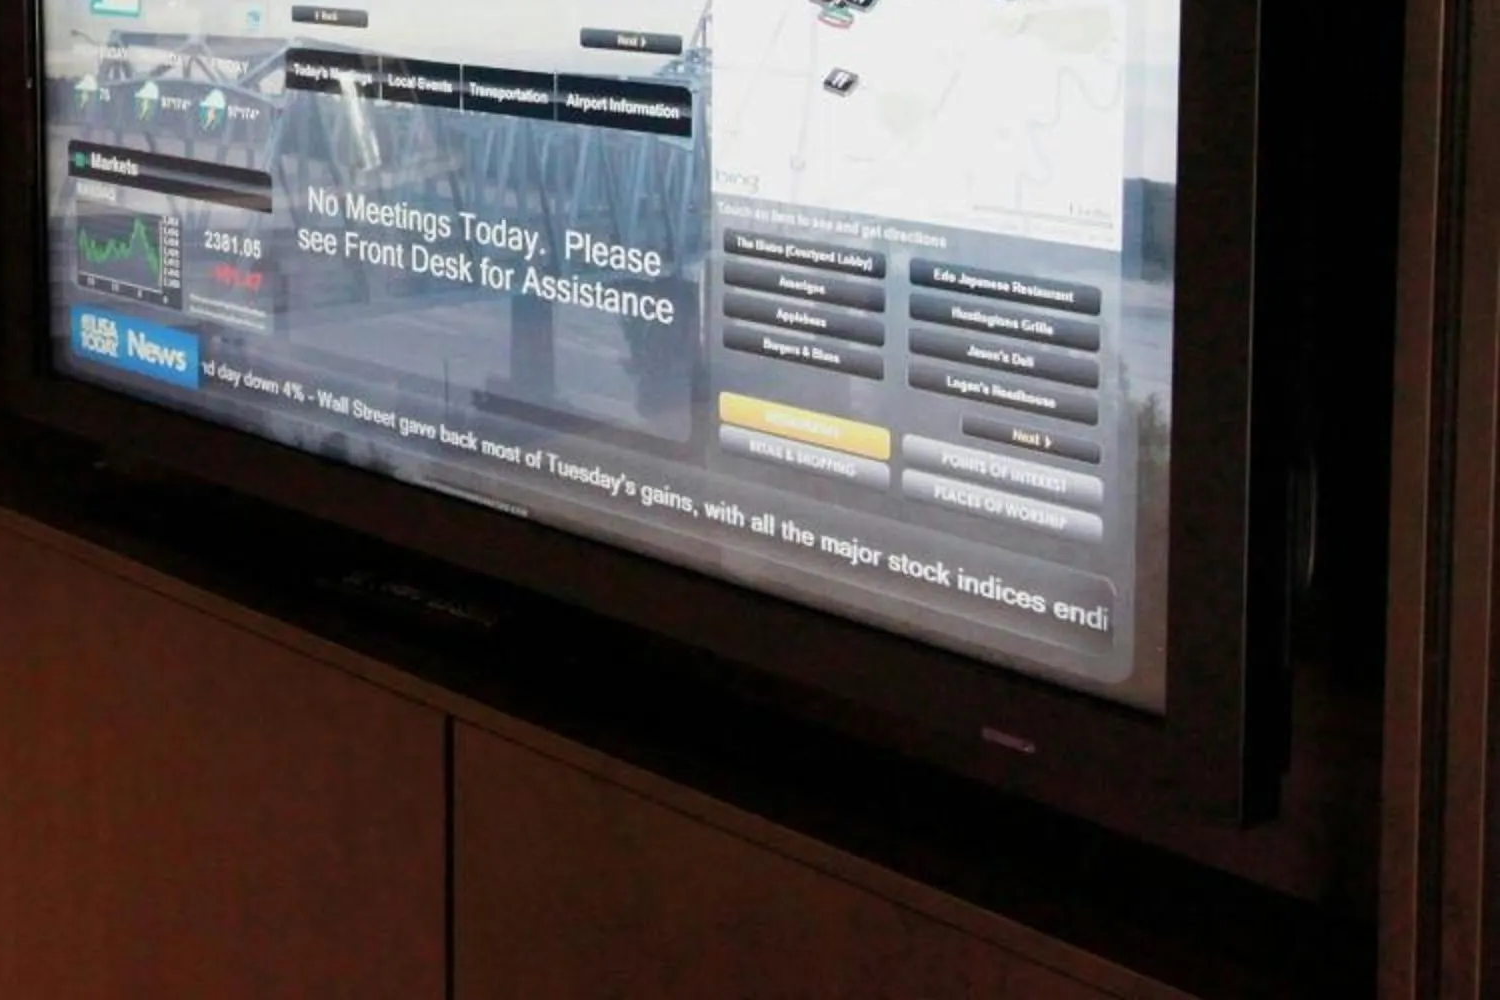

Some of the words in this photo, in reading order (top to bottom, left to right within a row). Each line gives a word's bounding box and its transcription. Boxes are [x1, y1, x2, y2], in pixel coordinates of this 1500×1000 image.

[387, 74, 416, 91] Local
[417, 77, 453, 95] Events
[469, 81, 550, 106] Transportation
[566, 92, 608, 112] Airport
[609, 96, 681, 121] Information
[90, 151, 139, 176] Markets
[306, 185, 340, 217] No
[345, 192, 453, 243] Meetings
[458, 211, 547, 261] Today.
[564, 230, 662, 277] Please
[835, 219, 860, 235] and
[861, 223, 883, 240] get
[203, 229, 263, 261] 2381.05
[297, 226, 338, 257] see
[344, 231, 405, 270] Front
[410, 245, 474, 284] Desk
[479, 256, 515, 292] for
[522, 268, 675, 326] Assistance
[1011, 281, 1075, 304] Restaurant
[126, 329, 188, 372] News
[1012, 427, 1041, 447] Next
[989, 460, 1010, 480] OF
[217, 363, 242, 388] day
[243, 371, 280, 397] down
[281, 381, 306, 404] 4%
[316, 388, 350, 418] Wall
[352, 400, 397, 430] Street
[399, 416, 437, 441] gave
[439, 423, 478, 452] back
[480, 438, 522, 466] most
[524, 447, 545, 472] of
[546, 451, 637, 498] Tuesday's
[640, 483, 700, 519] gains,
[703, 497, 746, 530] with
[749, 510, 776, 538] all
[780, 519, 815, 549] the
[819, 534, 882, 569] major
[887, 550, 952, 587] stock
[956, 566, 1048, 615] indices
[1051, 598, 1109, 634] endi
[983, 494, 1004, 513] OF
